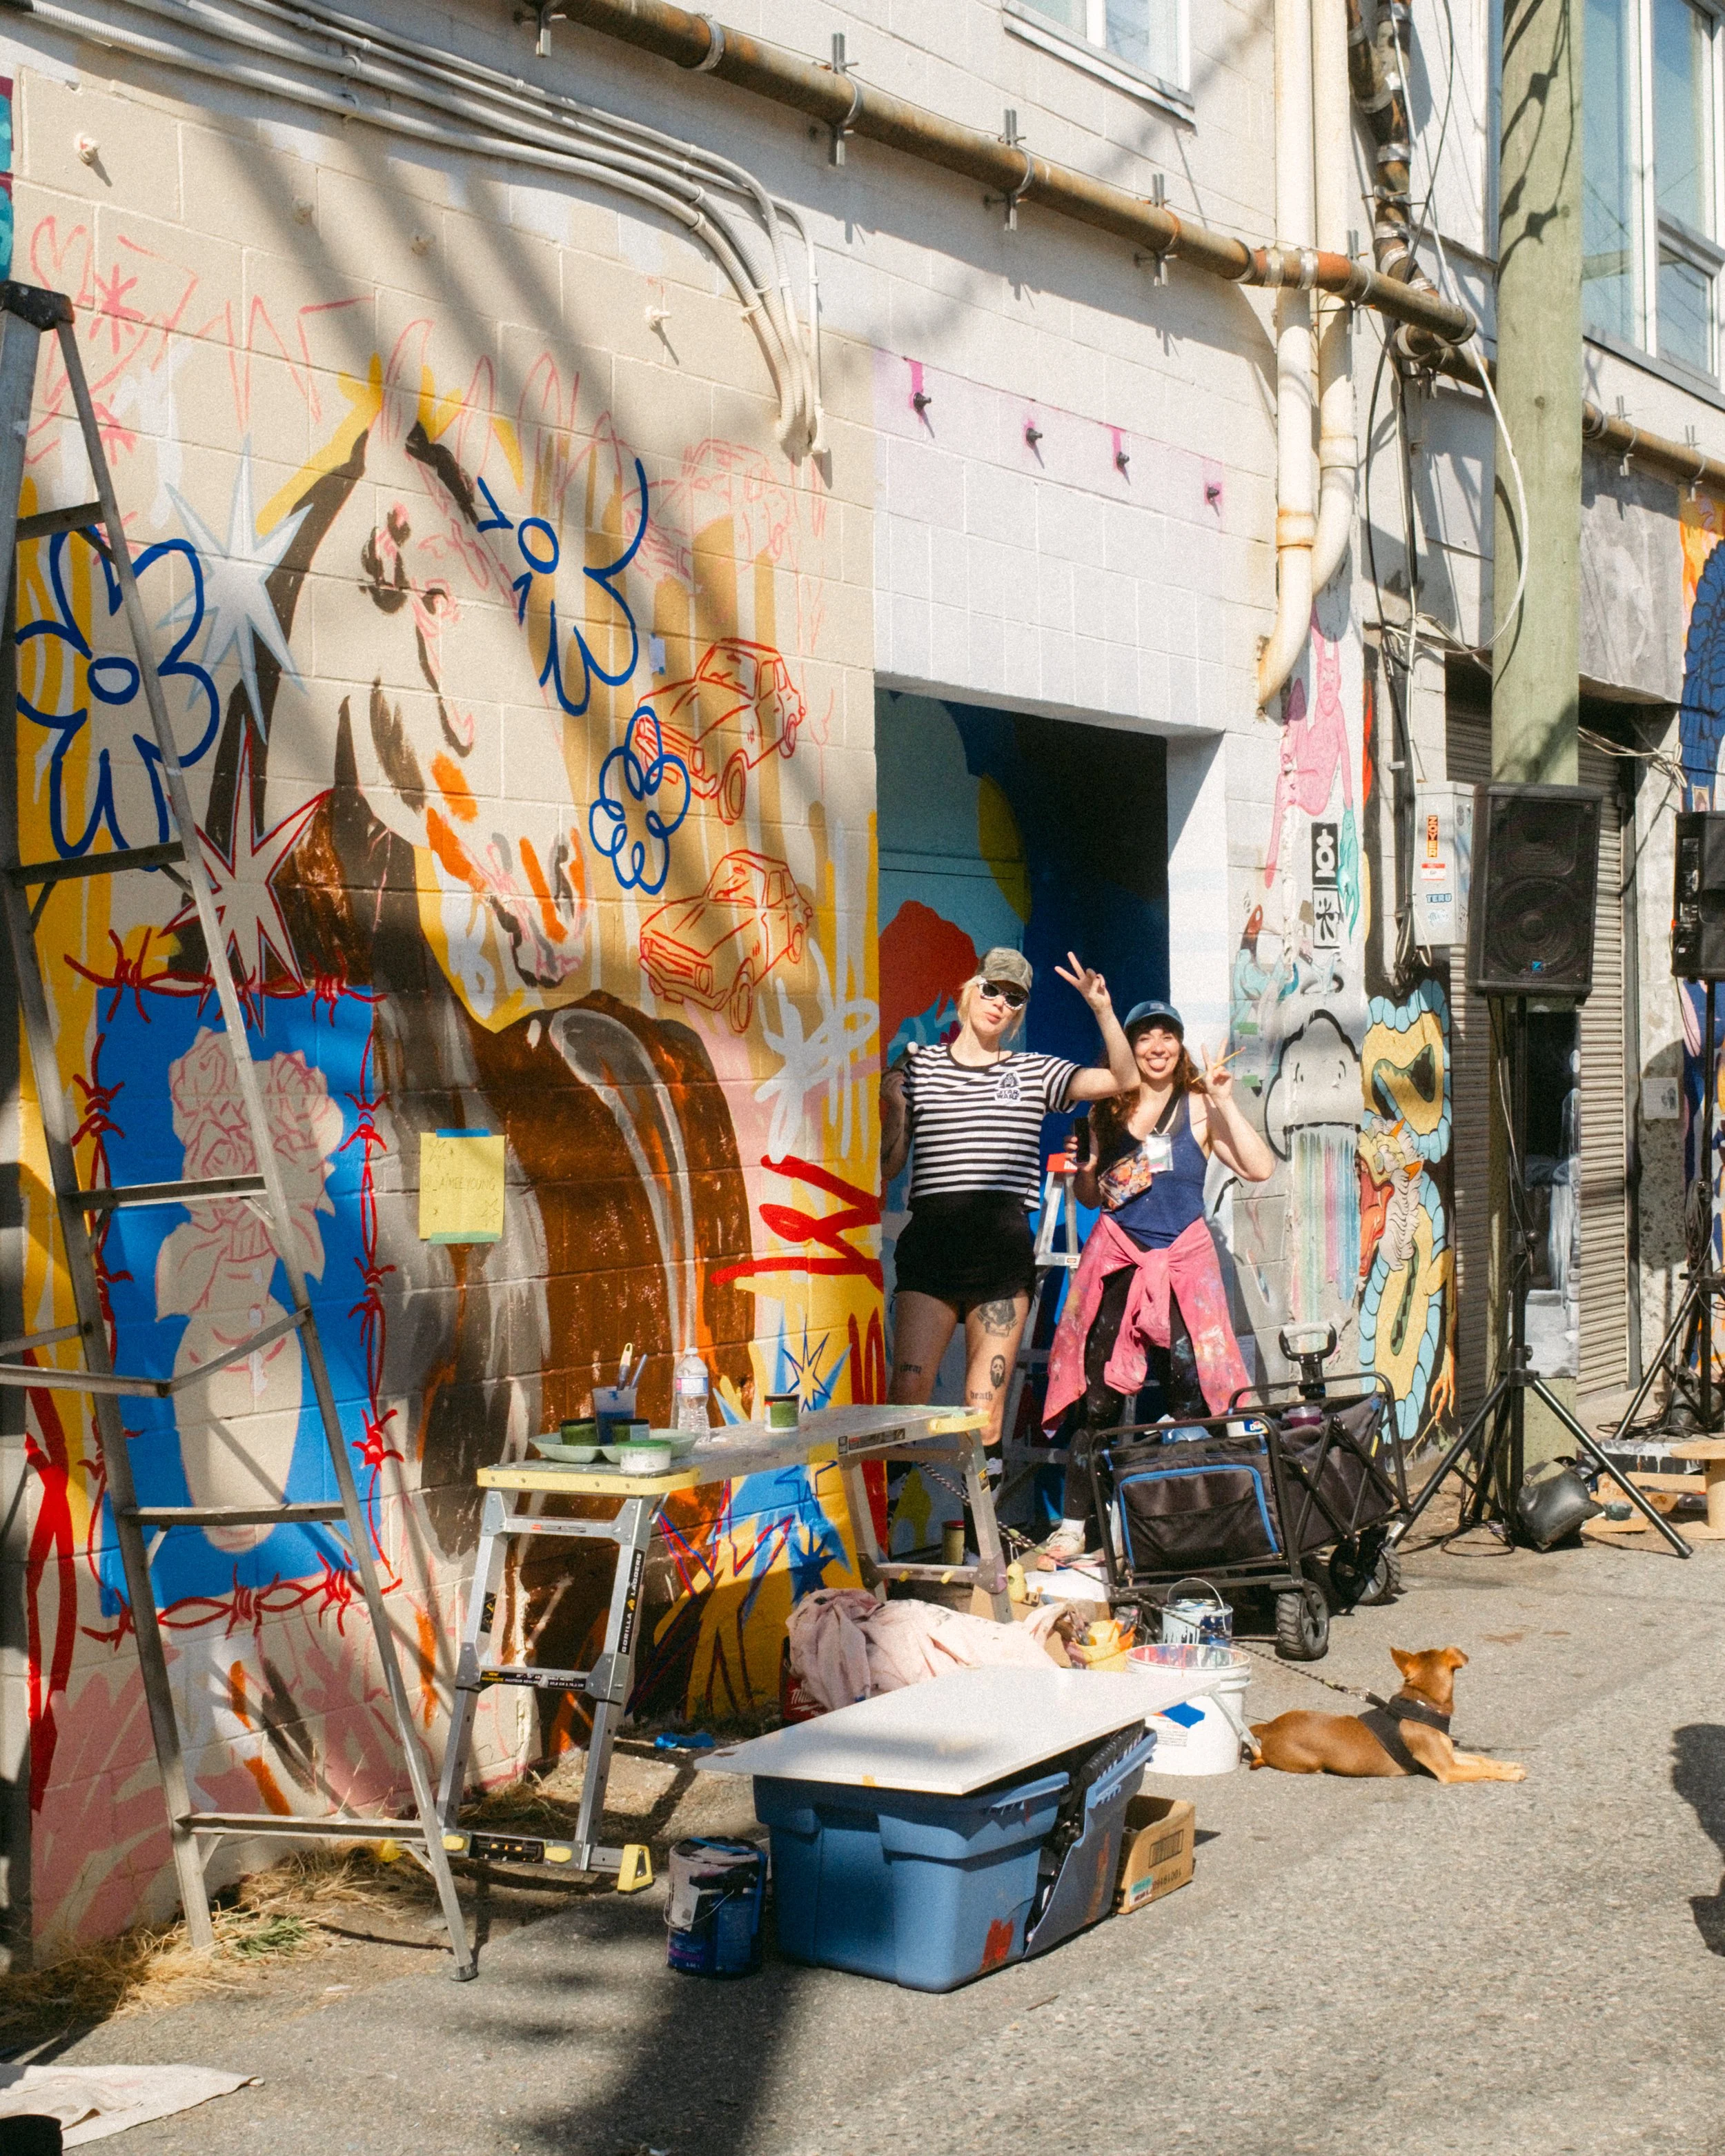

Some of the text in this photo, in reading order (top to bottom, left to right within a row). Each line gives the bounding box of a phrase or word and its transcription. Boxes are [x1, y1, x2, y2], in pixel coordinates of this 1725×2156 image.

[1426, 893, 1452, 903] TERU
[630, 1552, 642, 1596] LADDERS
[622, 1613, 633, 1653] GORILLA
